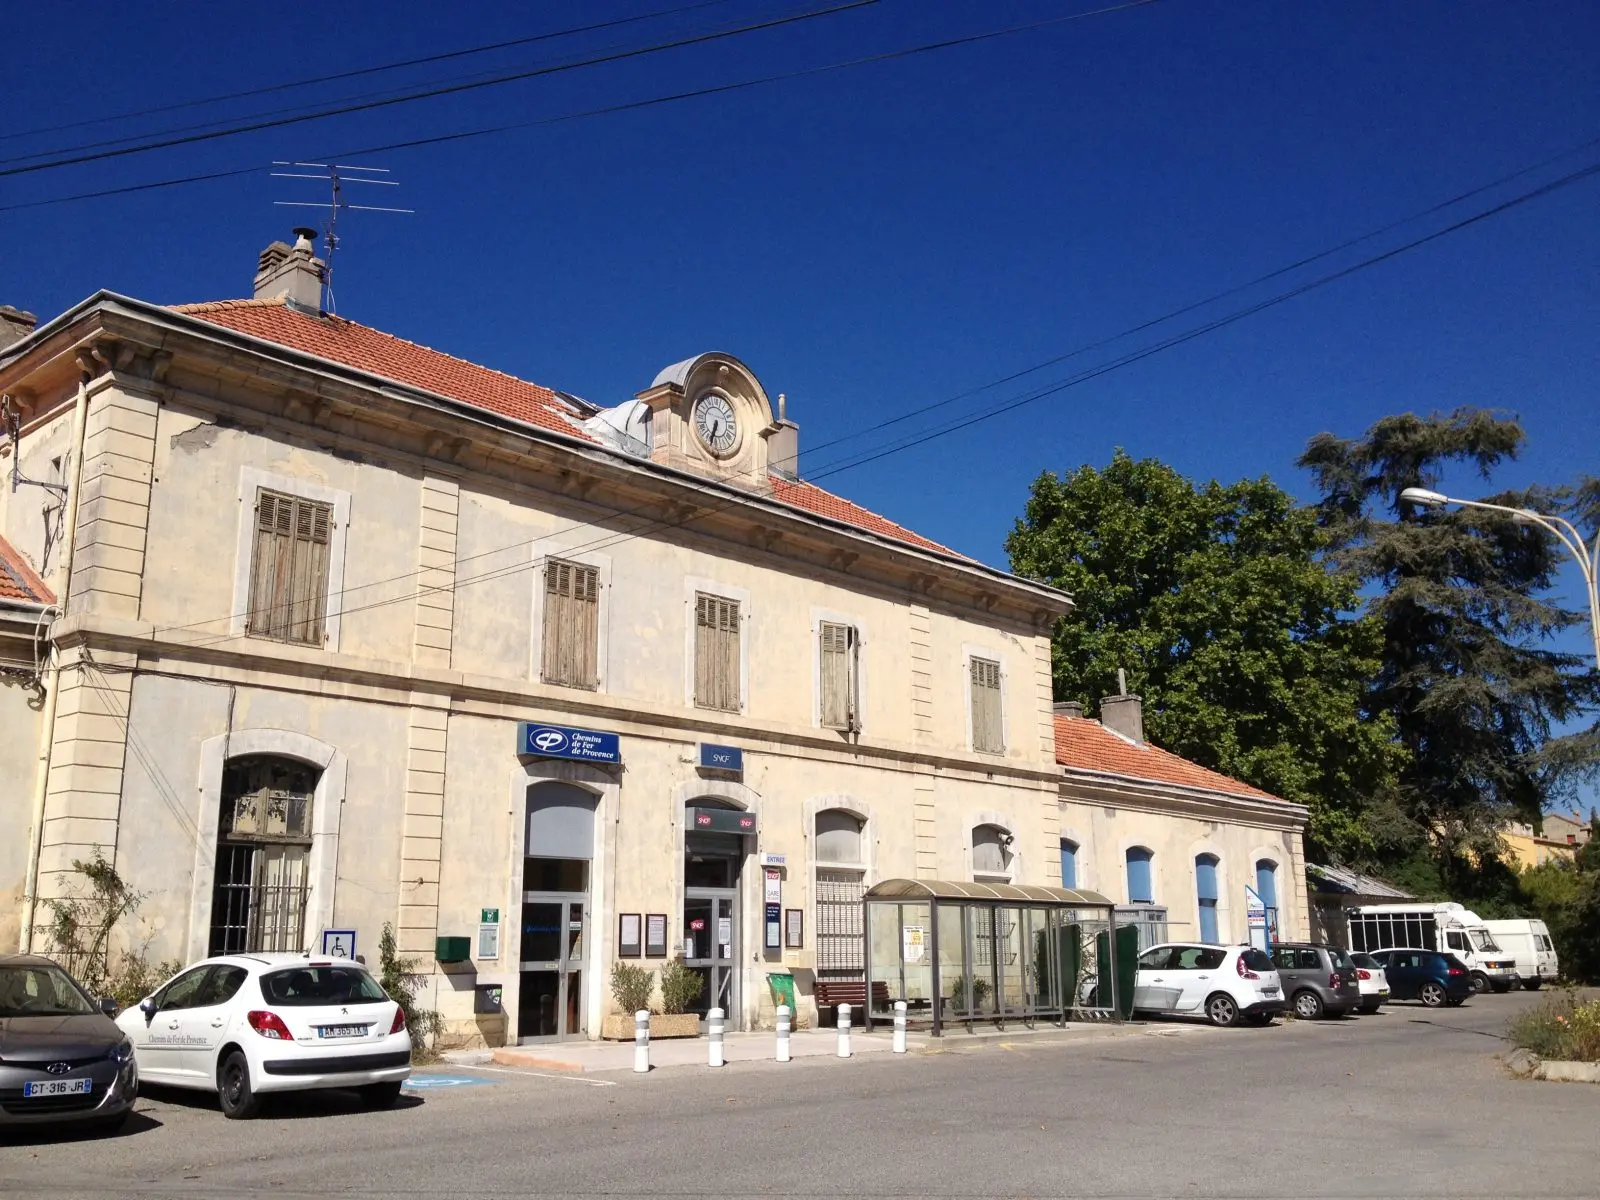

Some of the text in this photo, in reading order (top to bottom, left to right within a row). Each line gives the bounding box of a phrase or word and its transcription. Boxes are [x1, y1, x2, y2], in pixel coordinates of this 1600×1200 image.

[572, 732, 602, 744] Chemins
[582, 741, 595, 749] Fer
[582, 748, 614, 759] Provence
[713, 753, 731, 763] SNCF
